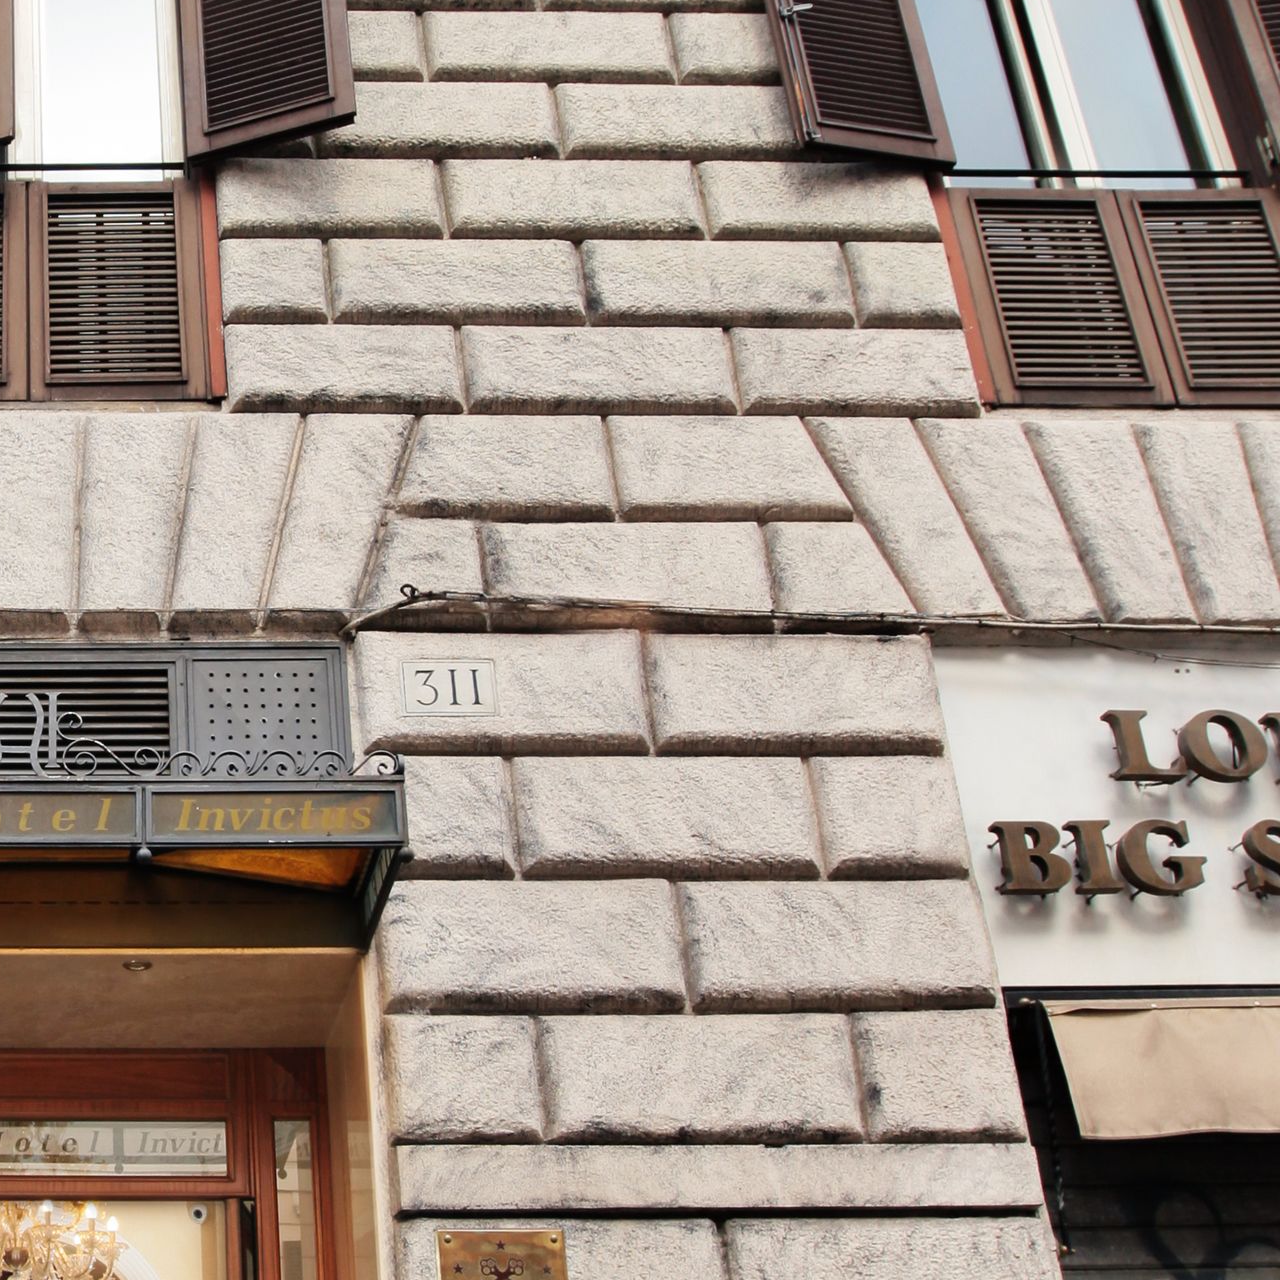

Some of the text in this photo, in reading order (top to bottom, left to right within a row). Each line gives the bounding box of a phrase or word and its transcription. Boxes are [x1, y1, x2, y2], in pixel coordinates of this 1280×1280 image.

[415, 669, 483, 706] 311
[174, 798, 372, 833] Invictus
[988, 819, 1208, 896] BIG
